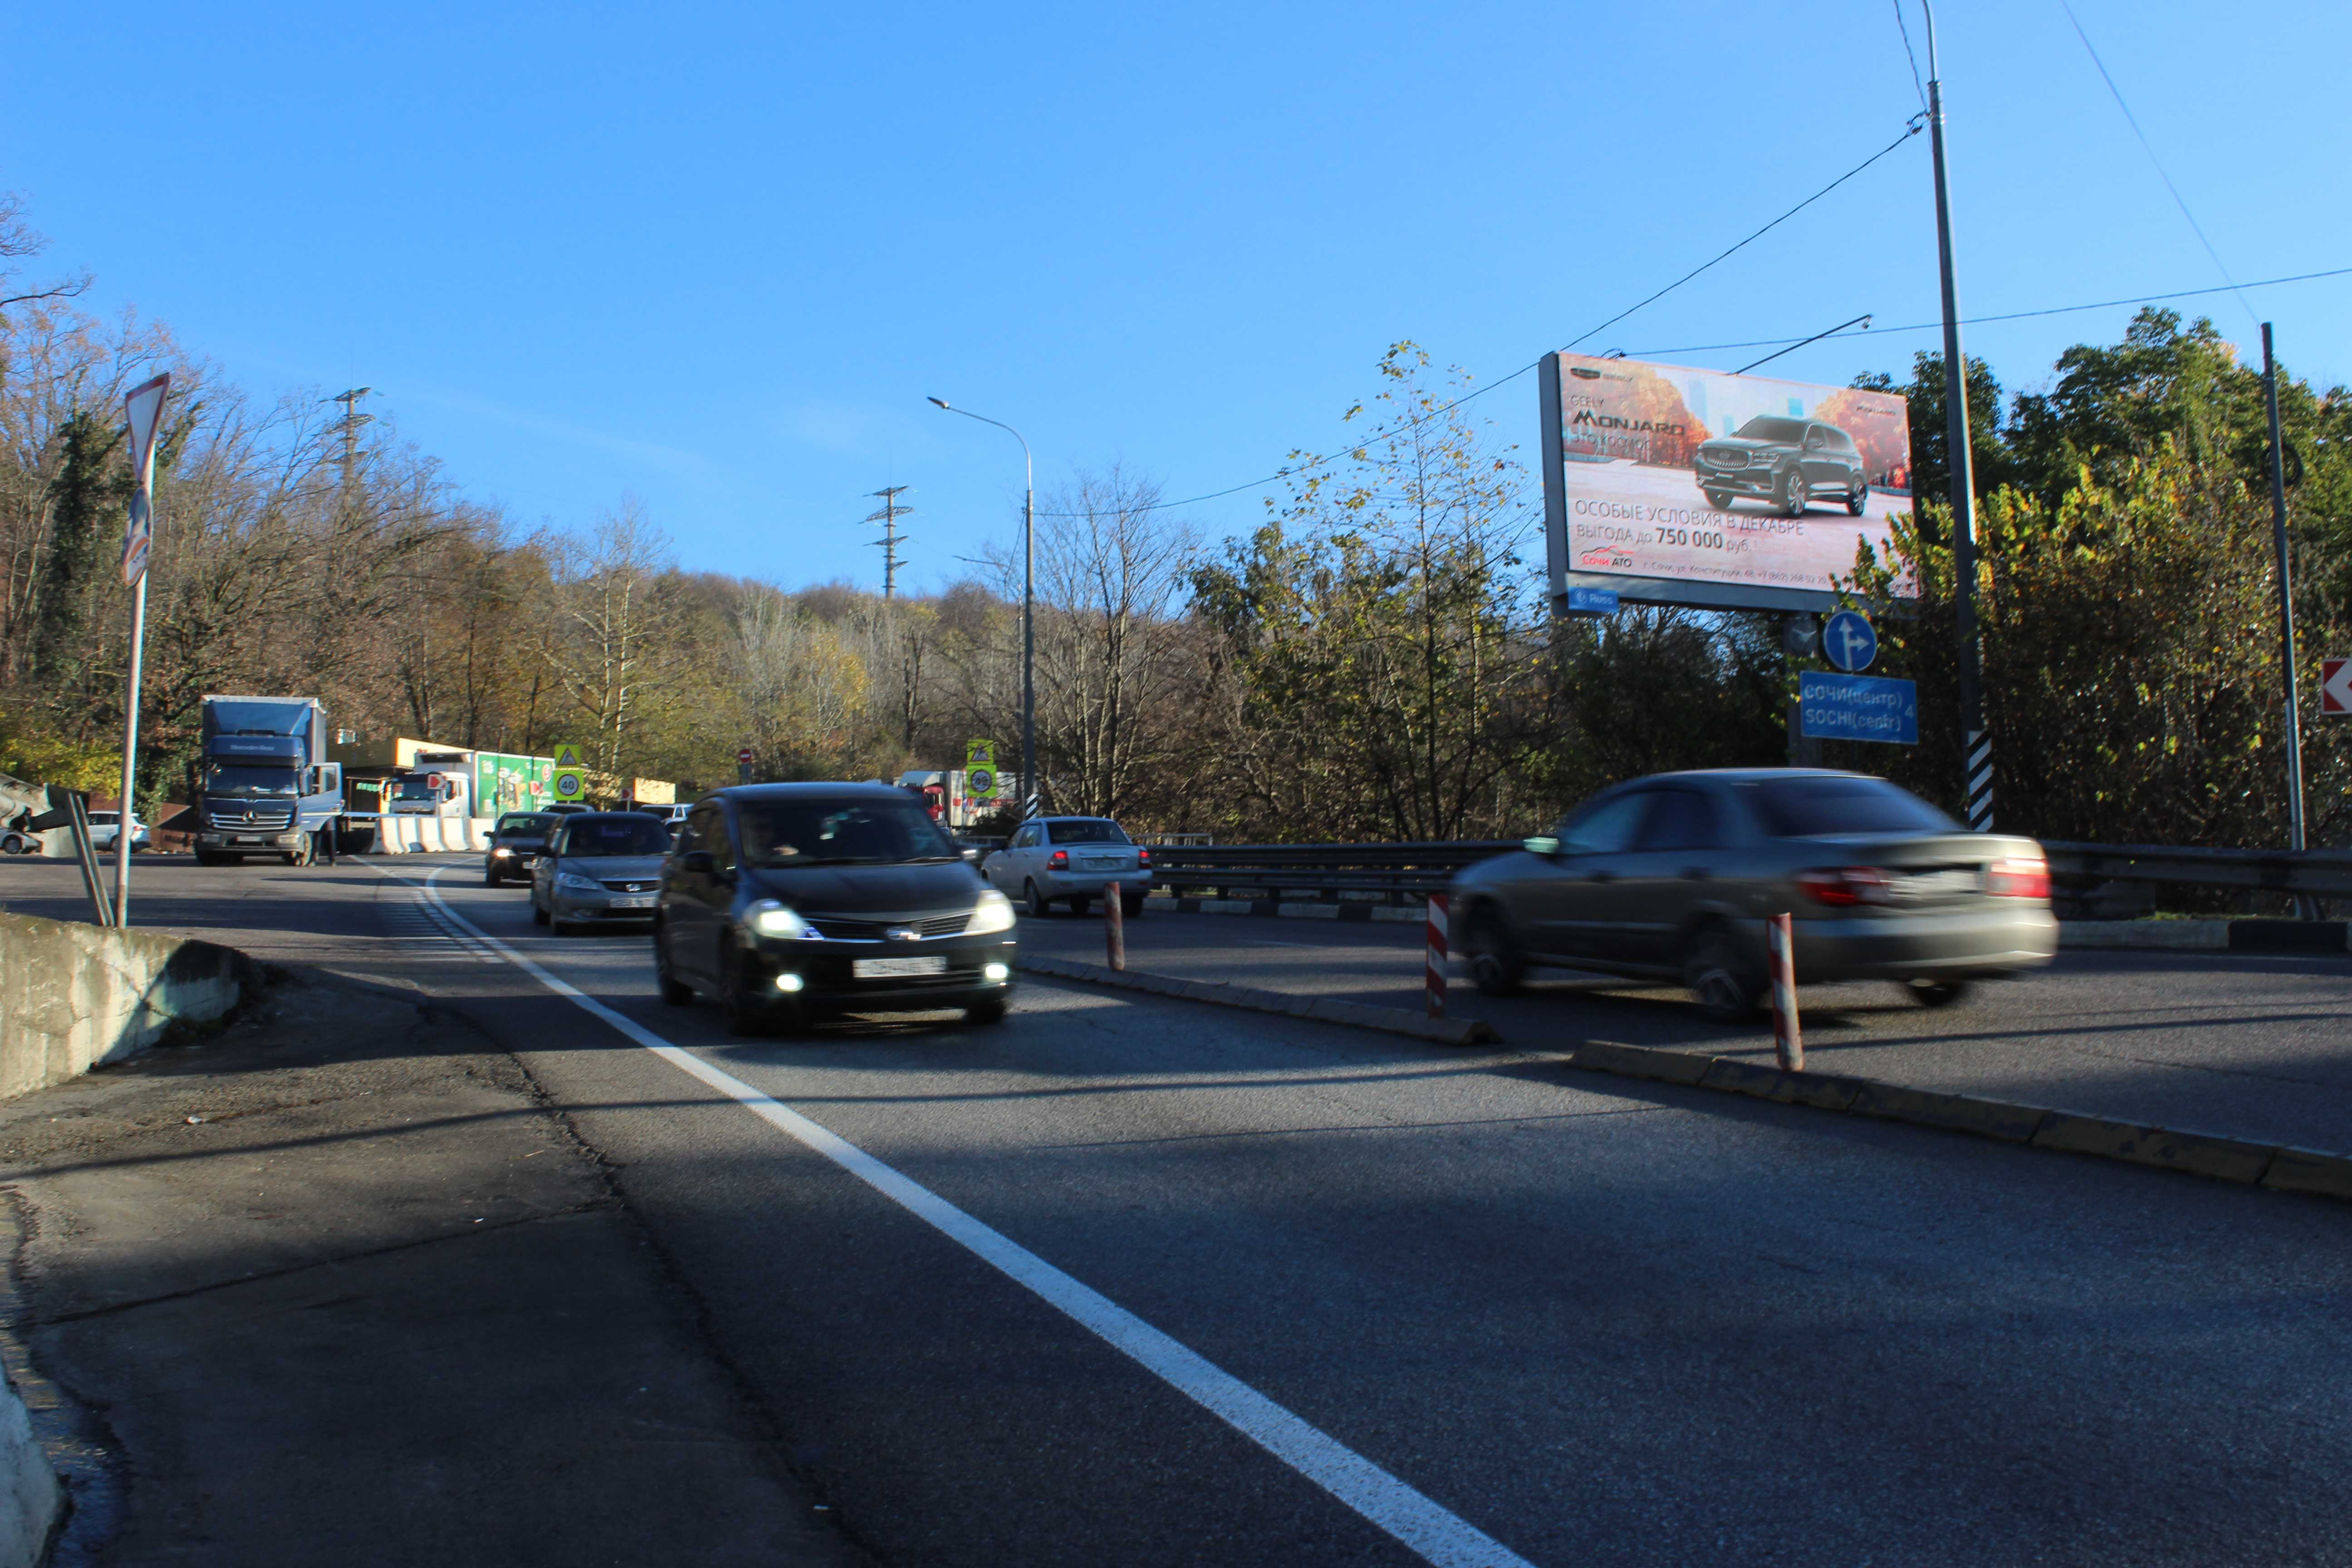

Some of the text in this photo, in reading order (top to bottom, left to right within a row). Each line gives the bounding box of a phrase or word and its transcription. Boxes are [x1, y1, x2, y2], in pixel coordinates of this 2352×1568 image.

[1570, 394, 1604, 409] GEELY
[1575, 500, 1804, 536] ОСОБЫЕ УСЛОВИЯ В ДЕКАБРЕ
[1576, 524, 1633, 543] ВЫГОДА
[1636, 532, 1652, 544] до
[1655, 527, 1687, 546] 750
[1692, 530, 1723, 549] 000
[1612, 558, 1632, 568] АТО
[1804, 684, 1903, 708] СОЧИ(центр)
[1905, 704, 1914, 719] 4
[562, 780, 575, 790] 40
